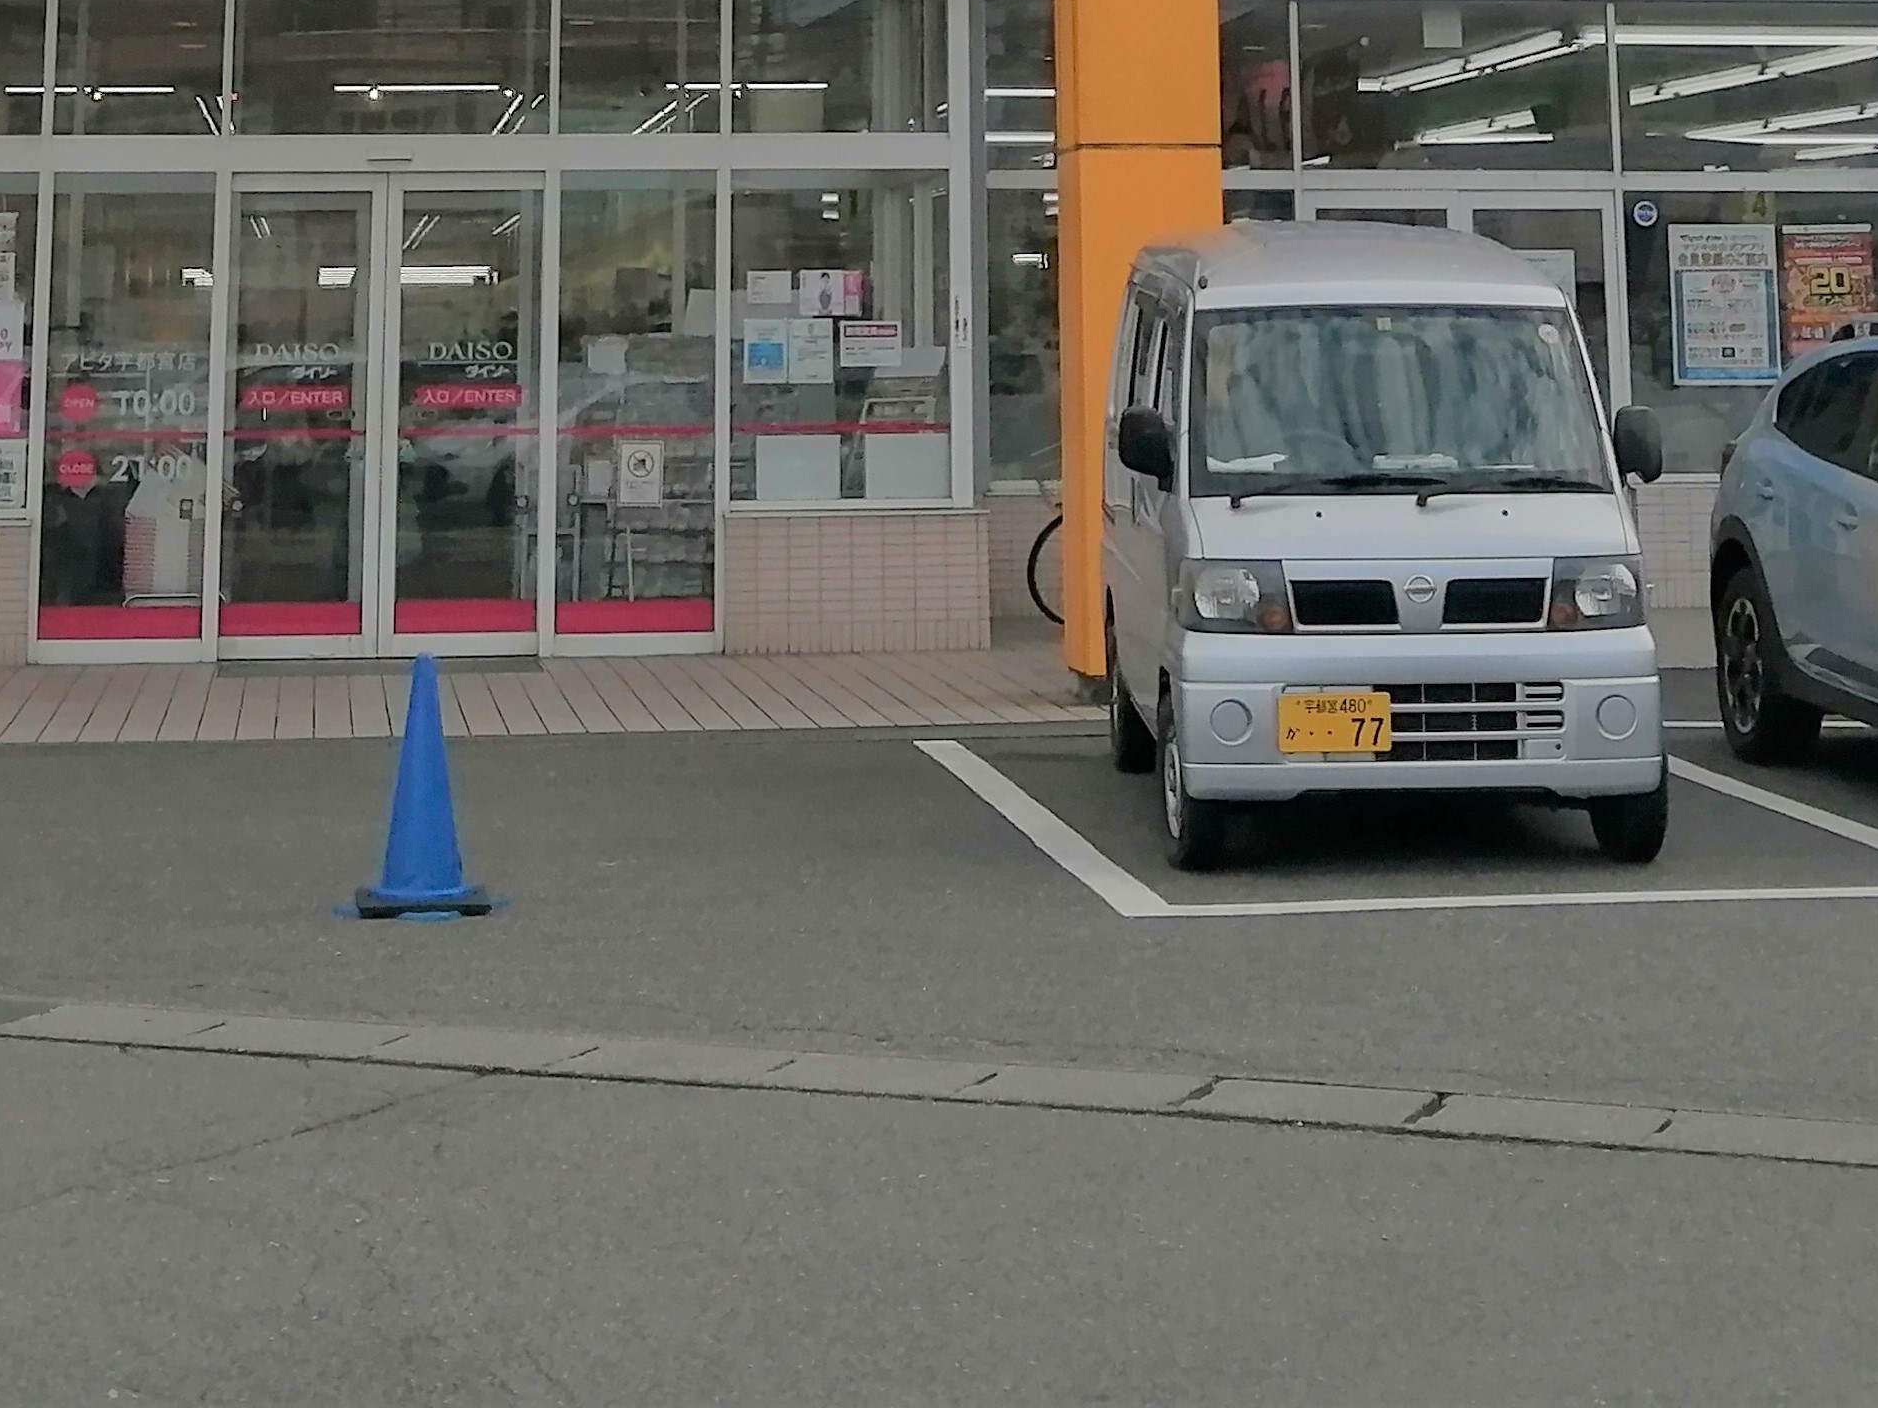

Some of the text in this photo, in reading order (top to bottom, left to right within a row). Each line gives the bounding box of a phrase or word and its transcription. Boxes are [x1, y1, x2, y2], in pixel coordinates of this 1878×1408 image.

[1810, 267, 1851, 295] 20
[255, 343, 340, 361] DAISO
[429, 341, 513, 360] DAISO
[112, 389, 195, 417] 10:00
[109, 454, 192, 482] 21:00
